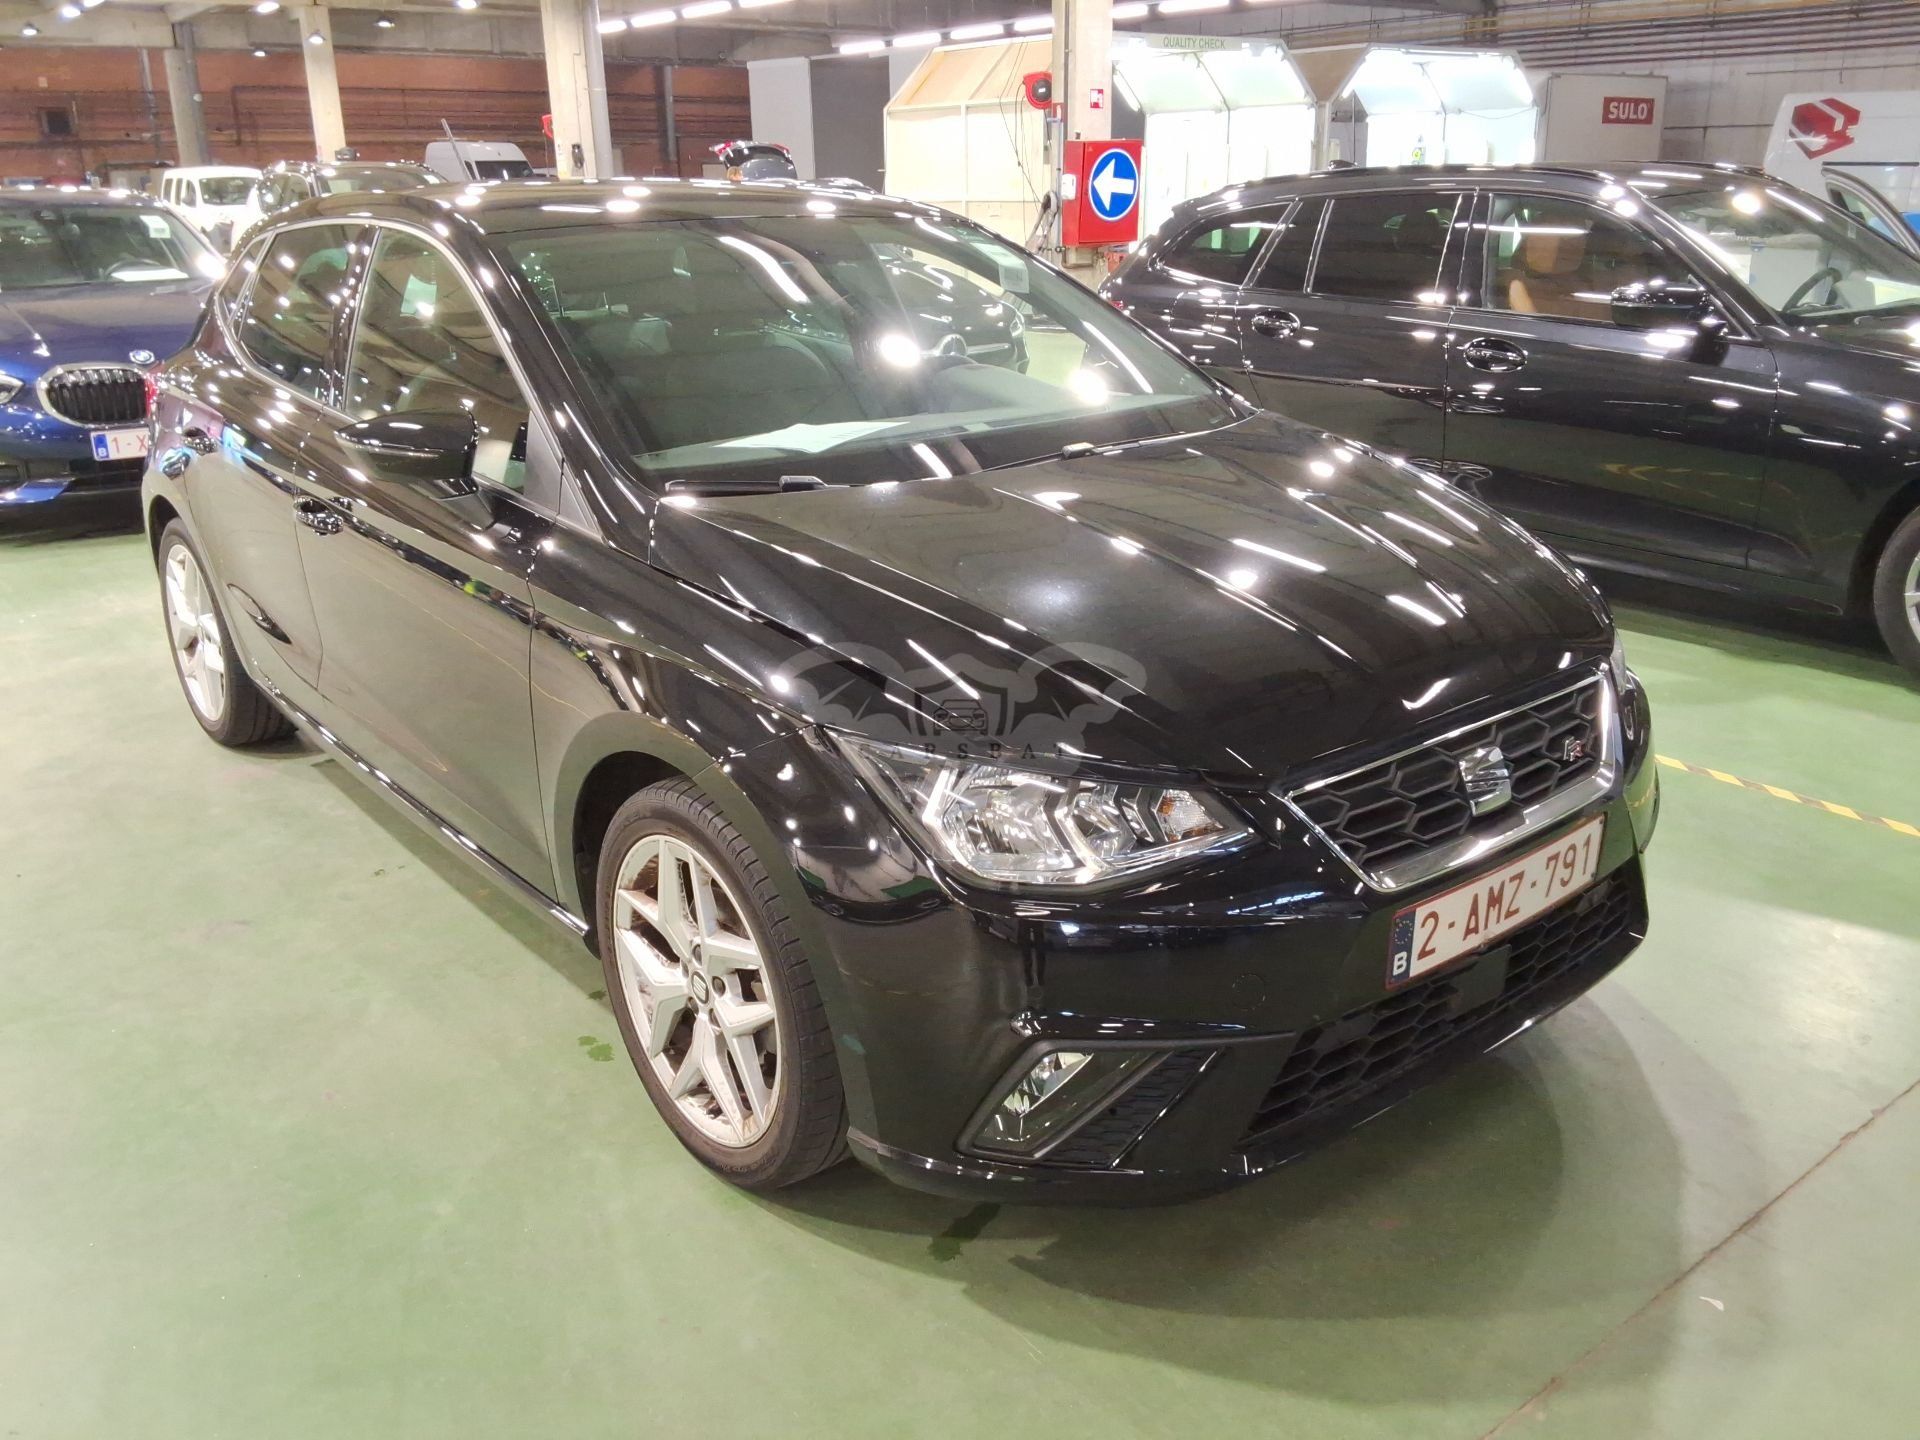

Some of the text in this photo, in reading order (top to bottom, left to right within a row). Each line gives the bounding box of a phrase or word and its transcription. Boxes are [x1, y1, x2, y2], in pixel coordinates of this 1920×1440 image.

[1163, 36, 1225, 49] QUALITY CHECK
[1608, 101, 1648, 120] SULO
[1416, 833, 1592, 961] 2-AMZ-791
[1392, 950, 1408, 976] B
